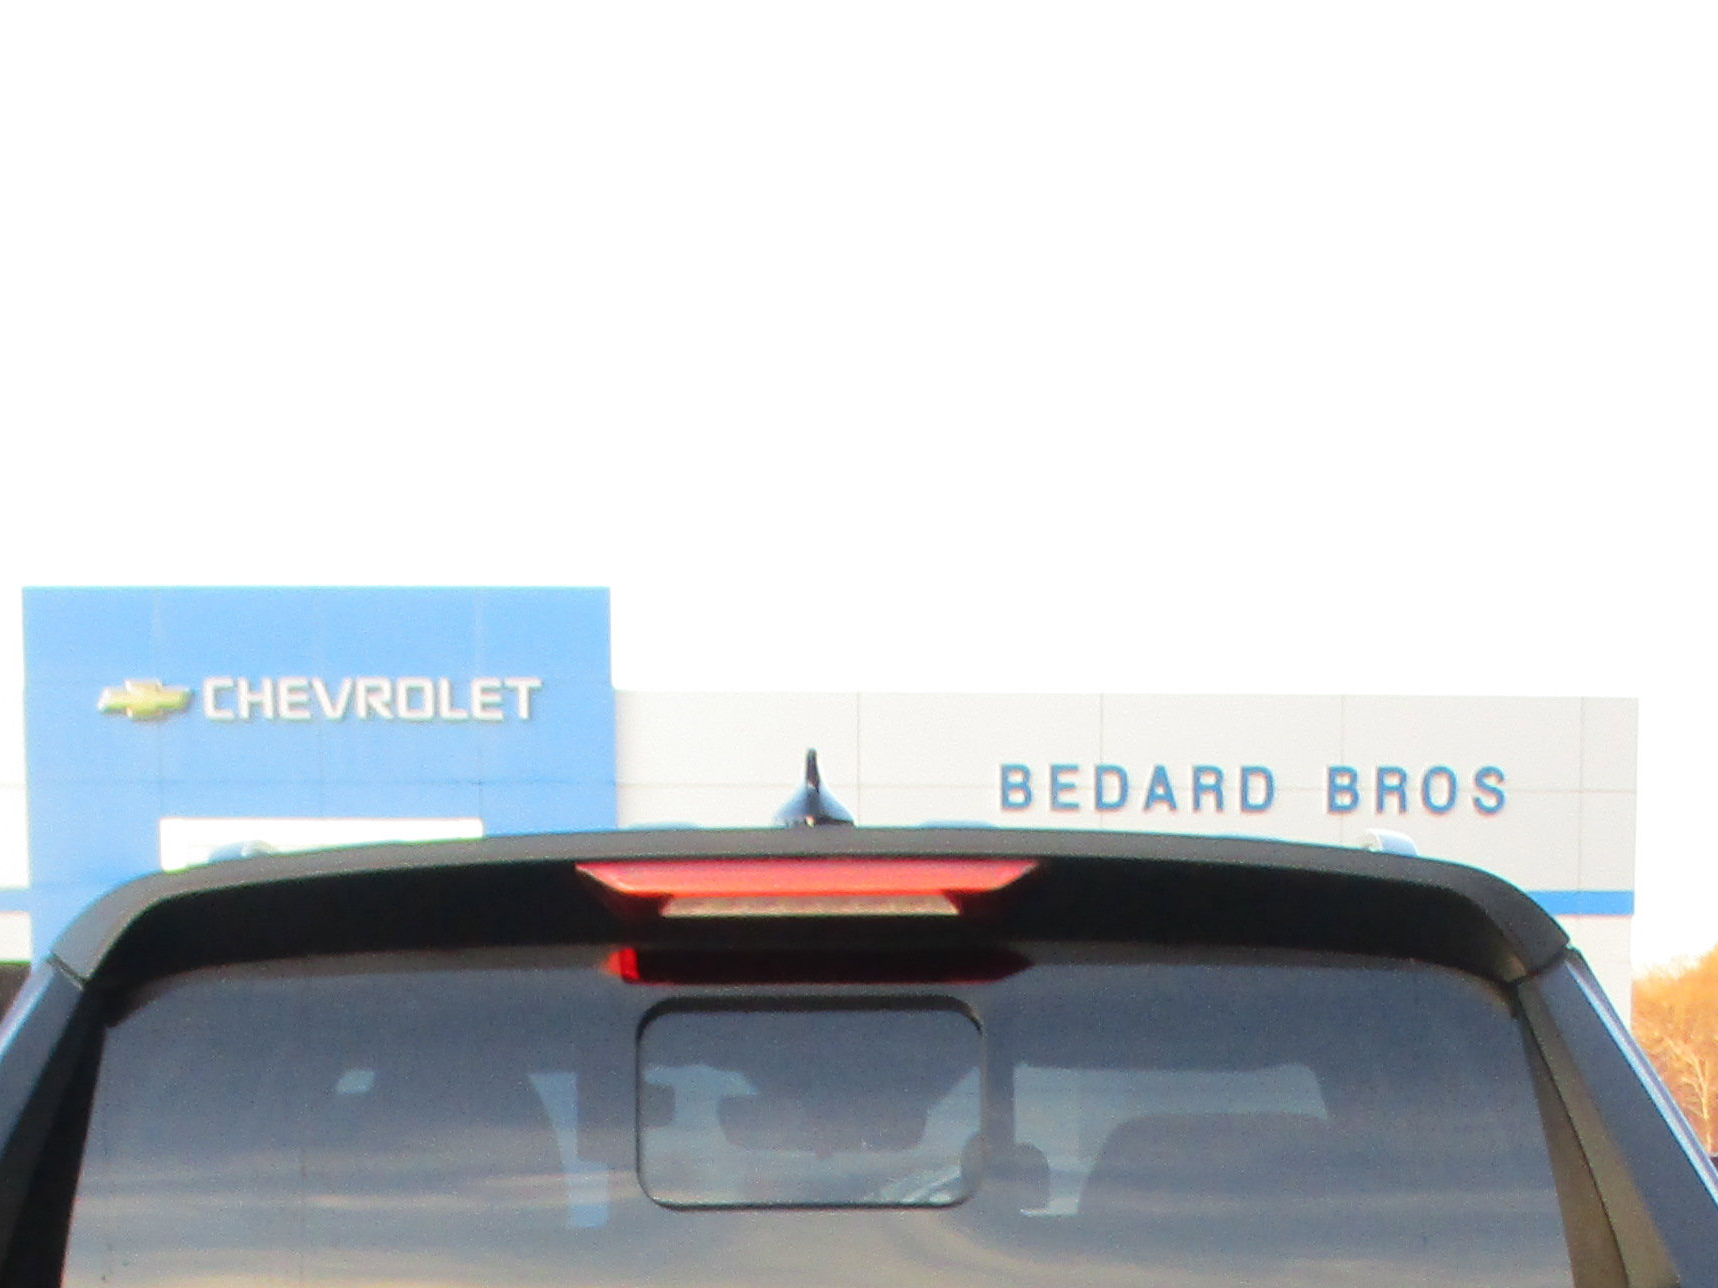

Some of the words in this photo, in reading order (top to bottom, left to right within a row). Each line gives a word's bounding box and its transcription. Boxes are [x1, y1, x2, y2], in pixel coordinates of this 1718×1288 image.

[202, 676, 543, 721] CHEVROLET
[1000, 763, 1275, 813] BEDARD
[1326, 765, 1506, 815] BROS
